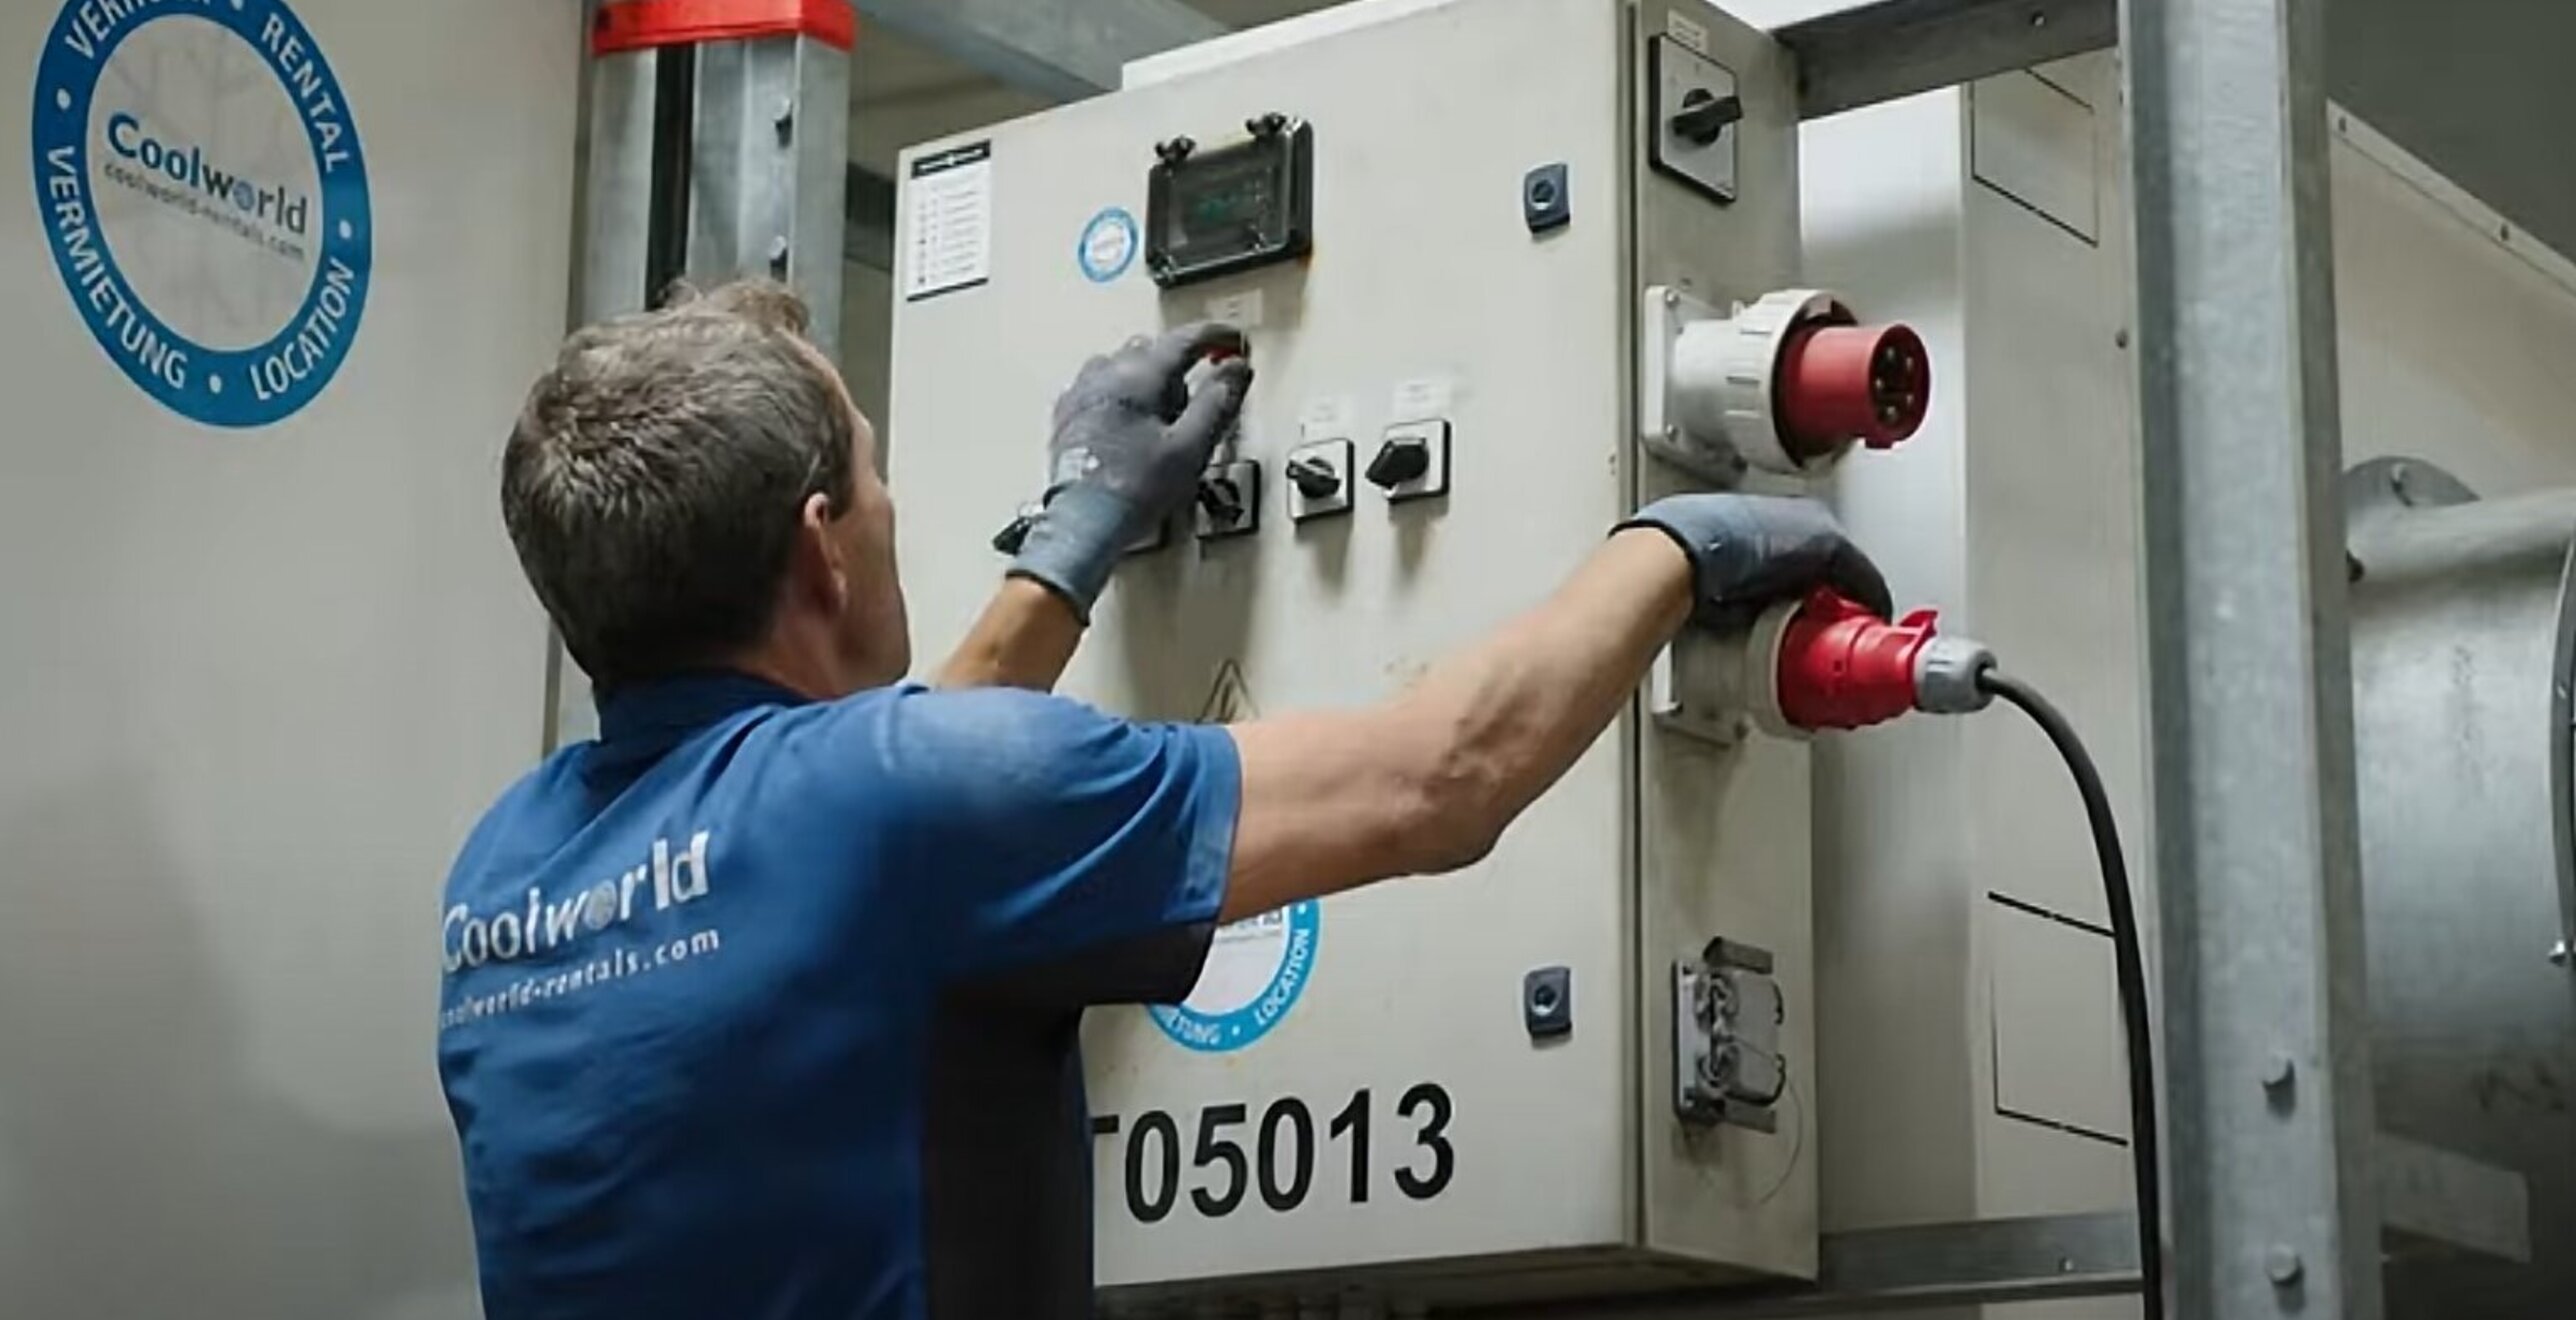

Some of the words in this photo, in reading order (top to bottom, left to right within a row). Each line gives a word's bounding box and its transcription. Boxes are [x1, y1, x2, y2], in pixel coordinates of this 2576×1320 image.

[260, 13, 349, 172] RENTAL
[107, 113, 307, 234] Coolworld
[47, 146, 187, 390] VERMIETUNG
[250, 258, 354, 401] LOCATION
[443, 829, 709, 972] Coolworld
[1253, 929, 1311, 1025] LOCATION
